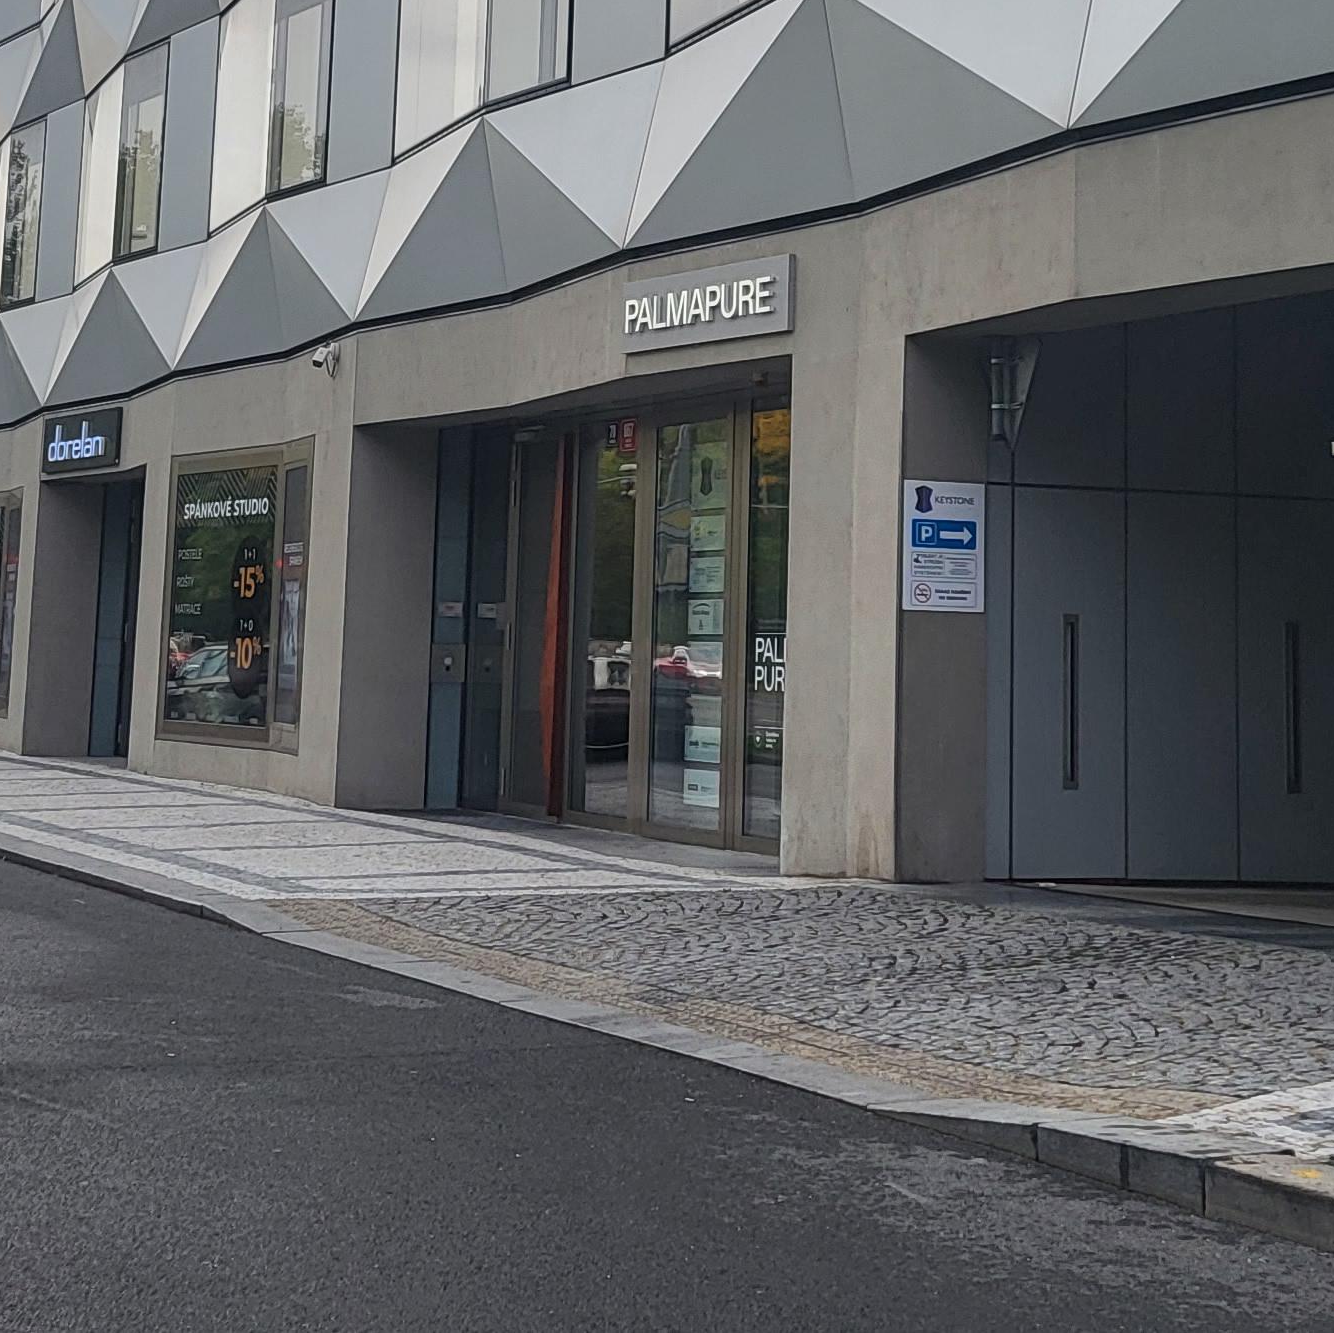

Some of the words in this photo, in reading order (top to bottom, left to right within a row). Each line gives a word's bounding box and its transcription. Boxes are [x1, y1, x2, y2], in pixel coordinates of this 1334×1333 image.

[624, 275, 775, 334] PALMAPURE
[48, 421, 107, 462] dorelan
[184, 496, 232, 520] SPÁNKOVÉ
[234, 498, 269, 516] STUDIO
[934, 496, 975, 506] KEYSTONE
[921, 525, 933, 542] P
[233, 565, 265, 599] -15%
[229, 637, 262, 669] -10%
